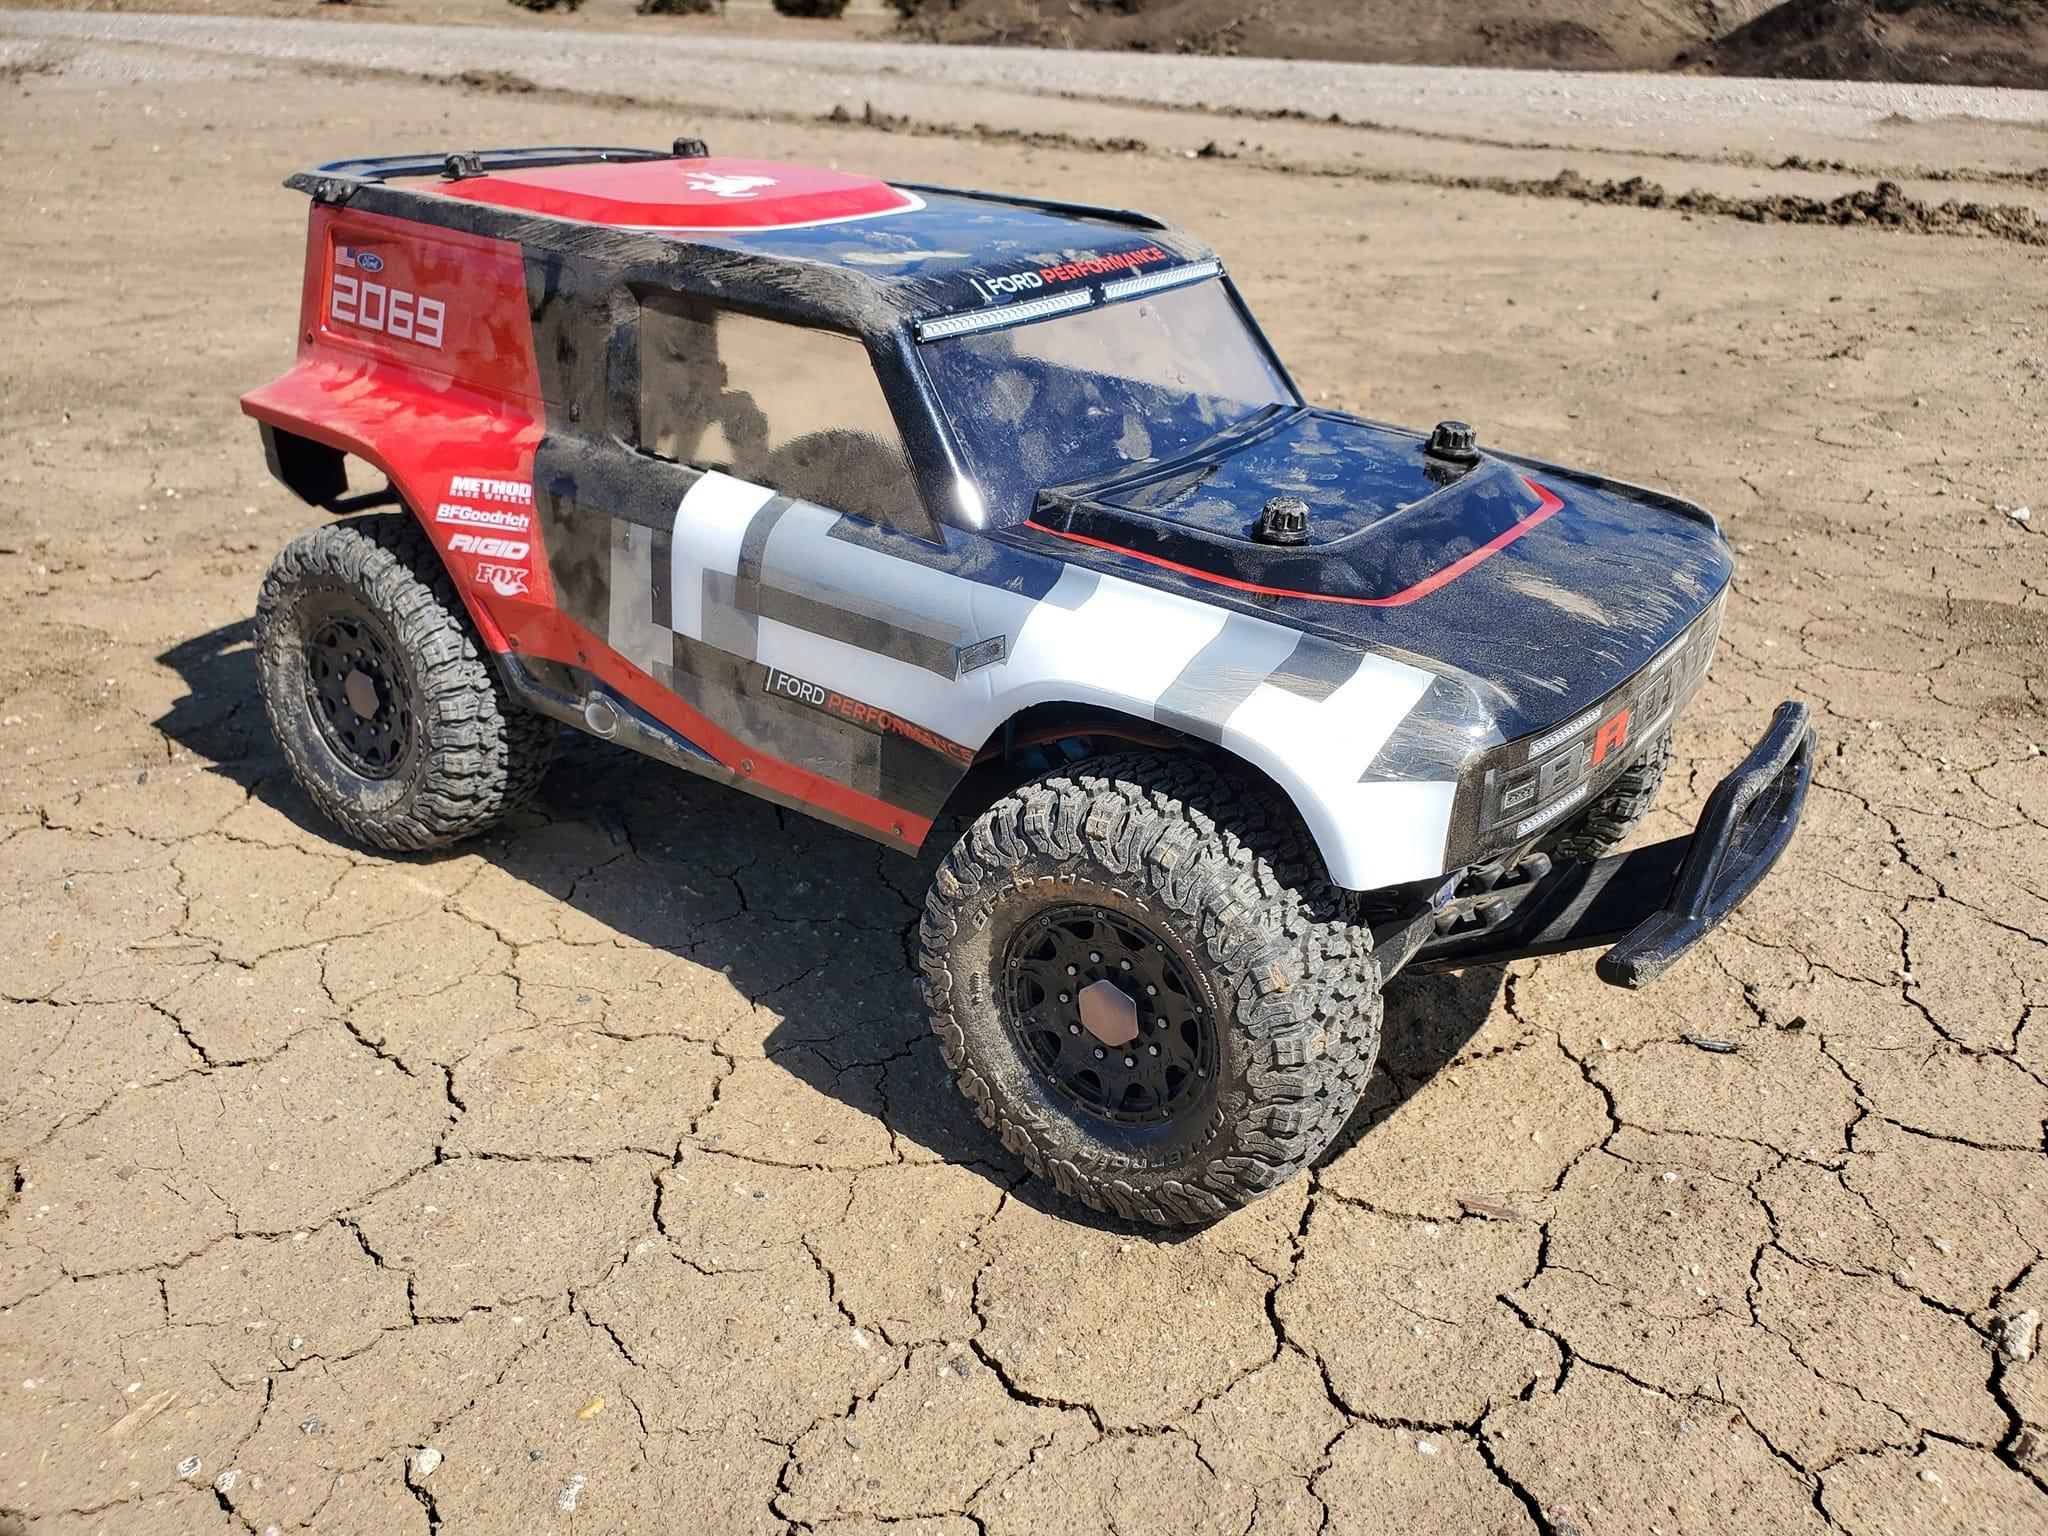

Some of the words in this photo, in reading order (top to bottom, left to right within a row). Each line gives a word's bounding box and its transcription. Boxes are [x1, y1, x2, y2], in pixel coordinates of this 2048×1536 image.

[361, 254, 381, 270] Ford
[984, 271, 1044, 295] FORD
[1039, 247, 1167, 284] PERFORMANCE
[332, 274, 445, 348] 2069
[449, 490, 479, 499] RACE
[484, 493, 531, 505] WHEELS
[450, 475, 532, 498] METHOD
[436, 503, 530, 528] BFGoodrich
[447, 533, 530, 560] RIGID
[475, 562, 529, 588] FOX
[776, 673, 825, 705] FORD
[828, 691, 973, 761] PERFORMANCE
